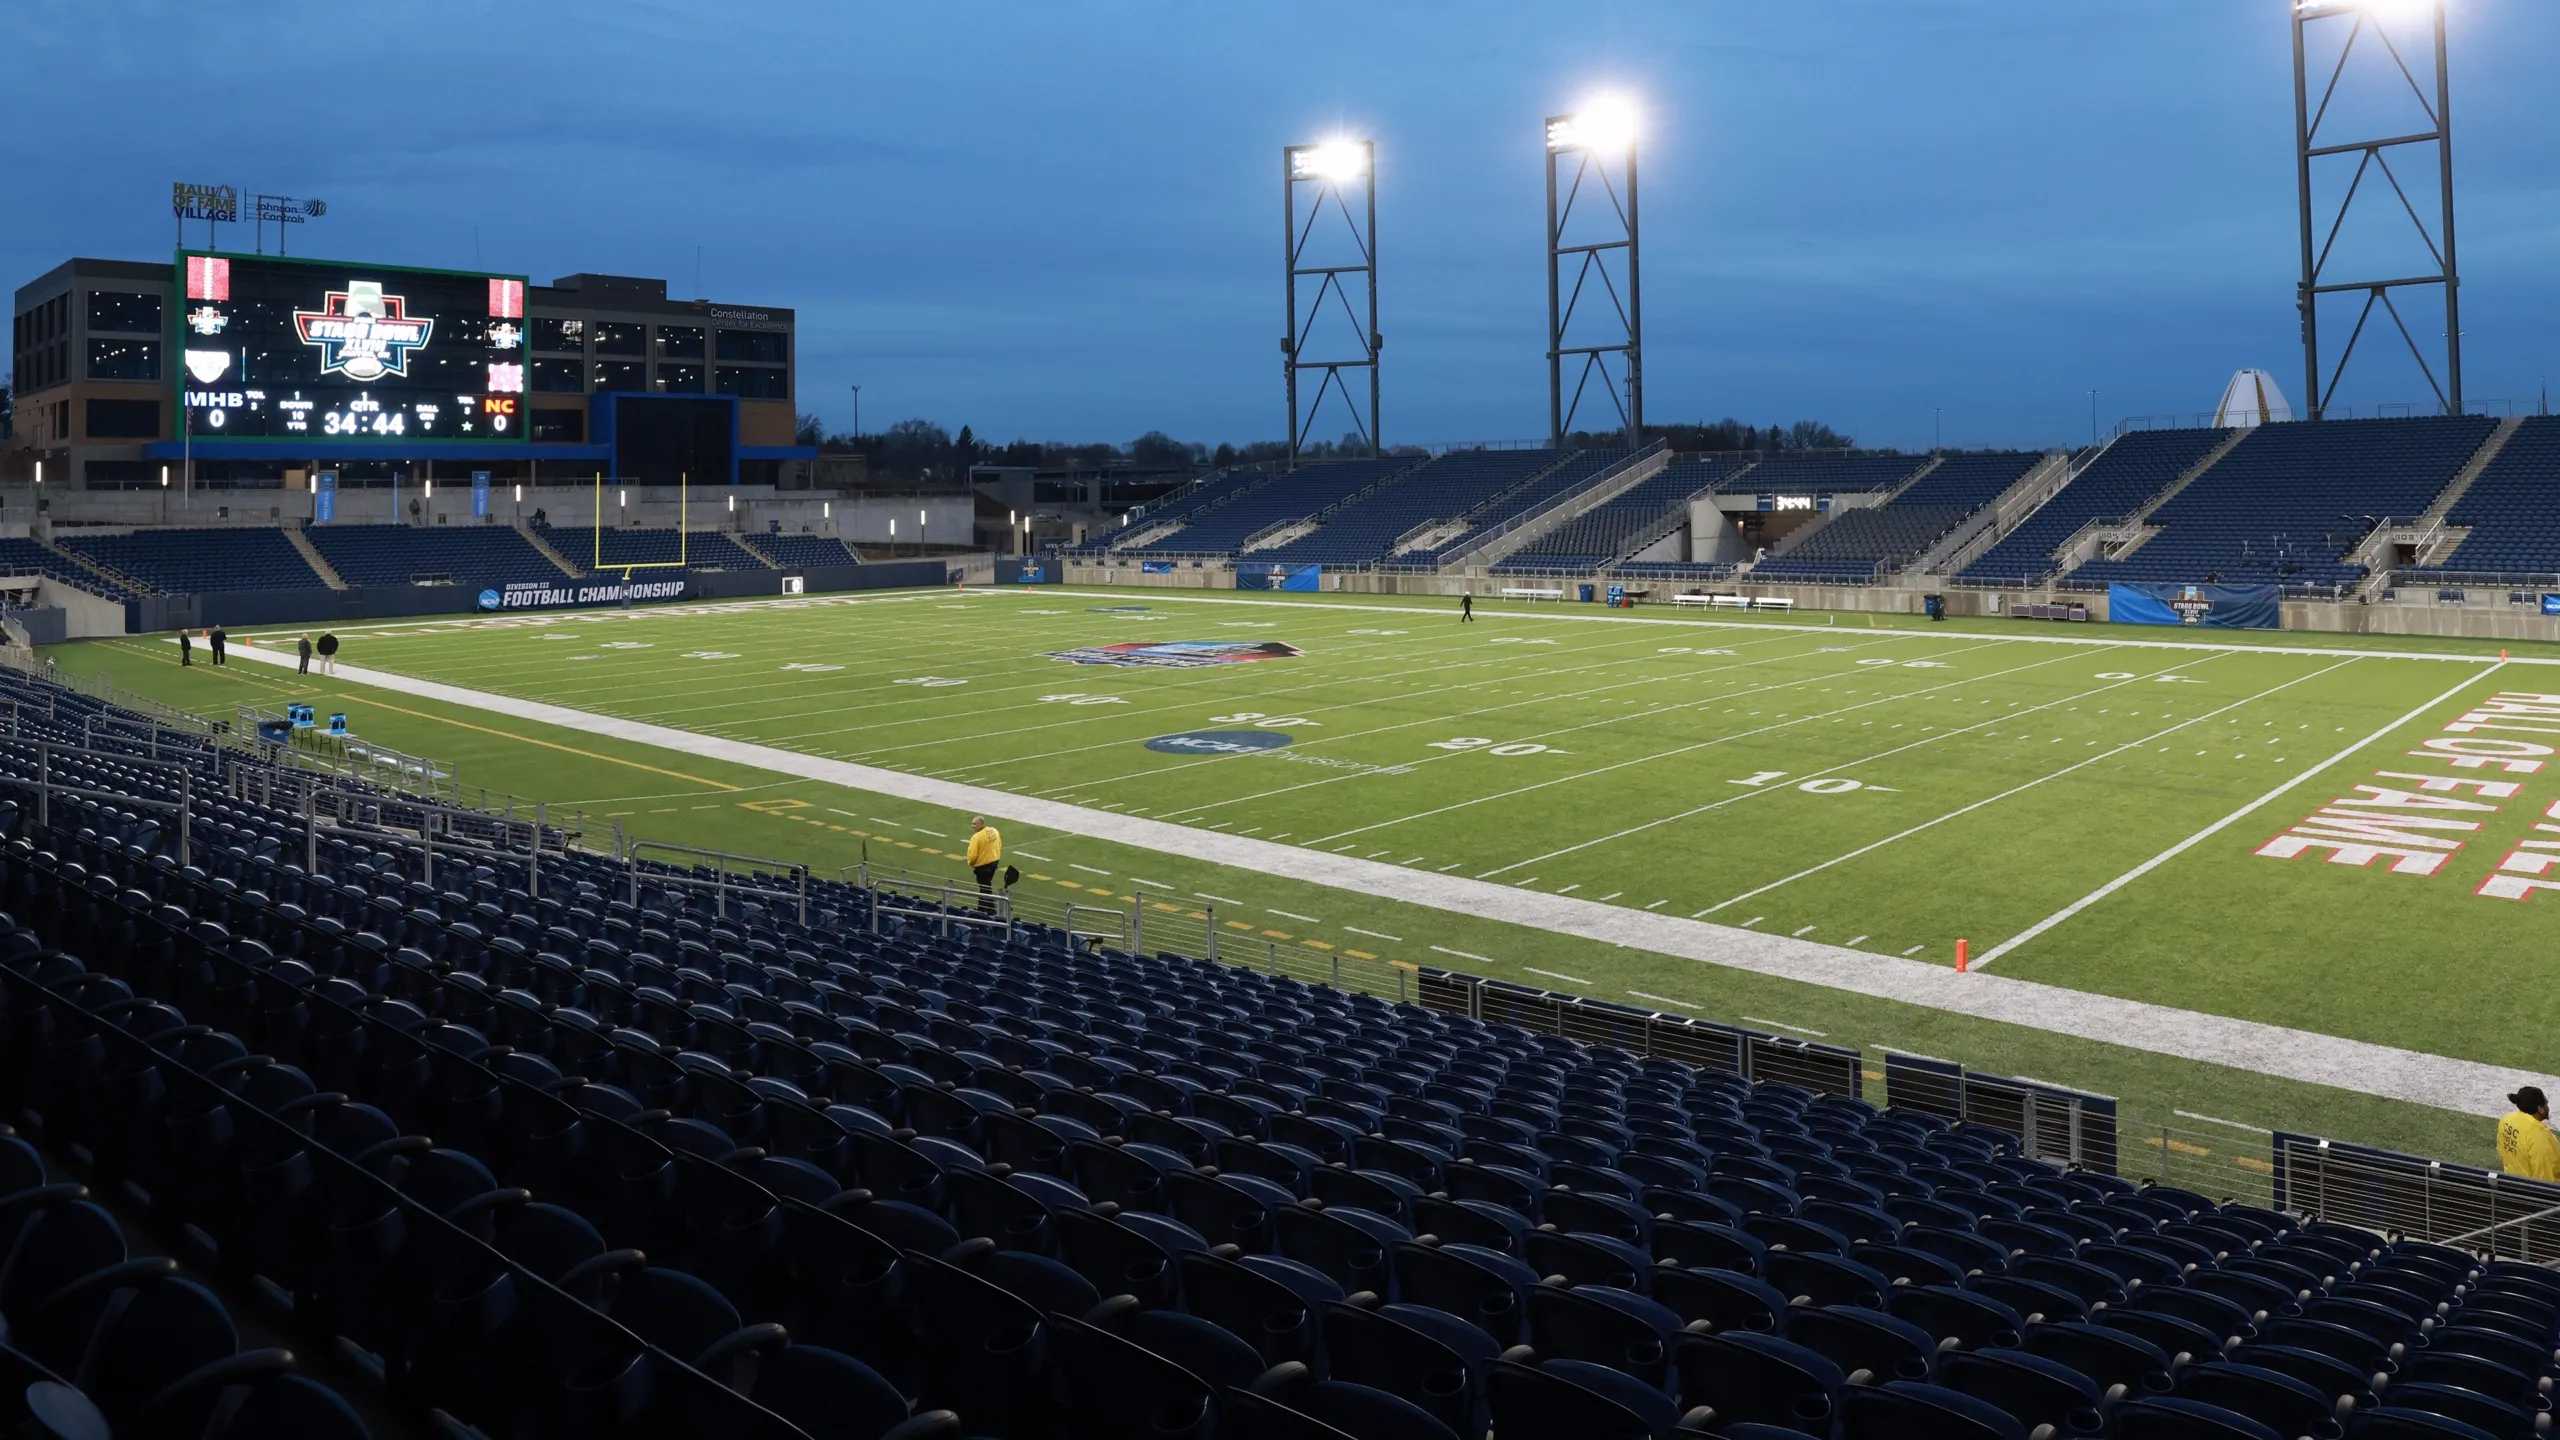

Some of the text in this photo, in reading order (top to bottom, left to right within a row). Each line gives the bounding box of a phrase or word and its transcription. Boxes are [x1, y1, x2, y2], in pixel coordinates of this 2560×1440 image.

[174, 183, 215, 197] HALL
[173, 195, 236, 211] OF FAME
[256, 203, 297, 213] Johnson
[174, 206, 236, 222] VILLAGE
[263, 213, 304, 224] Controls
[710, 308, 769, 321] Constellation
[711, 319, 736, 328] Center
[738, 320, 748, 328] for
[350, 401, 379, 412] QTR
[485, 399, 513, 413] NC
[209, 409, 224, 427] 0
[291, 411, 304, 421] 10
[324, 412, 404, 435] 34:44
[494, 415, 506, 431] 0
[503, 588, 574, 607] FOOTBALL
[1209, 712, 1308, 728] 30
[1157, 737, 1263, 753] NCAA
[1427, 737, 1548, 756] 20
[1726, 771, 1862, 793] 10
[2250, 768, 2526, 877] FAME
